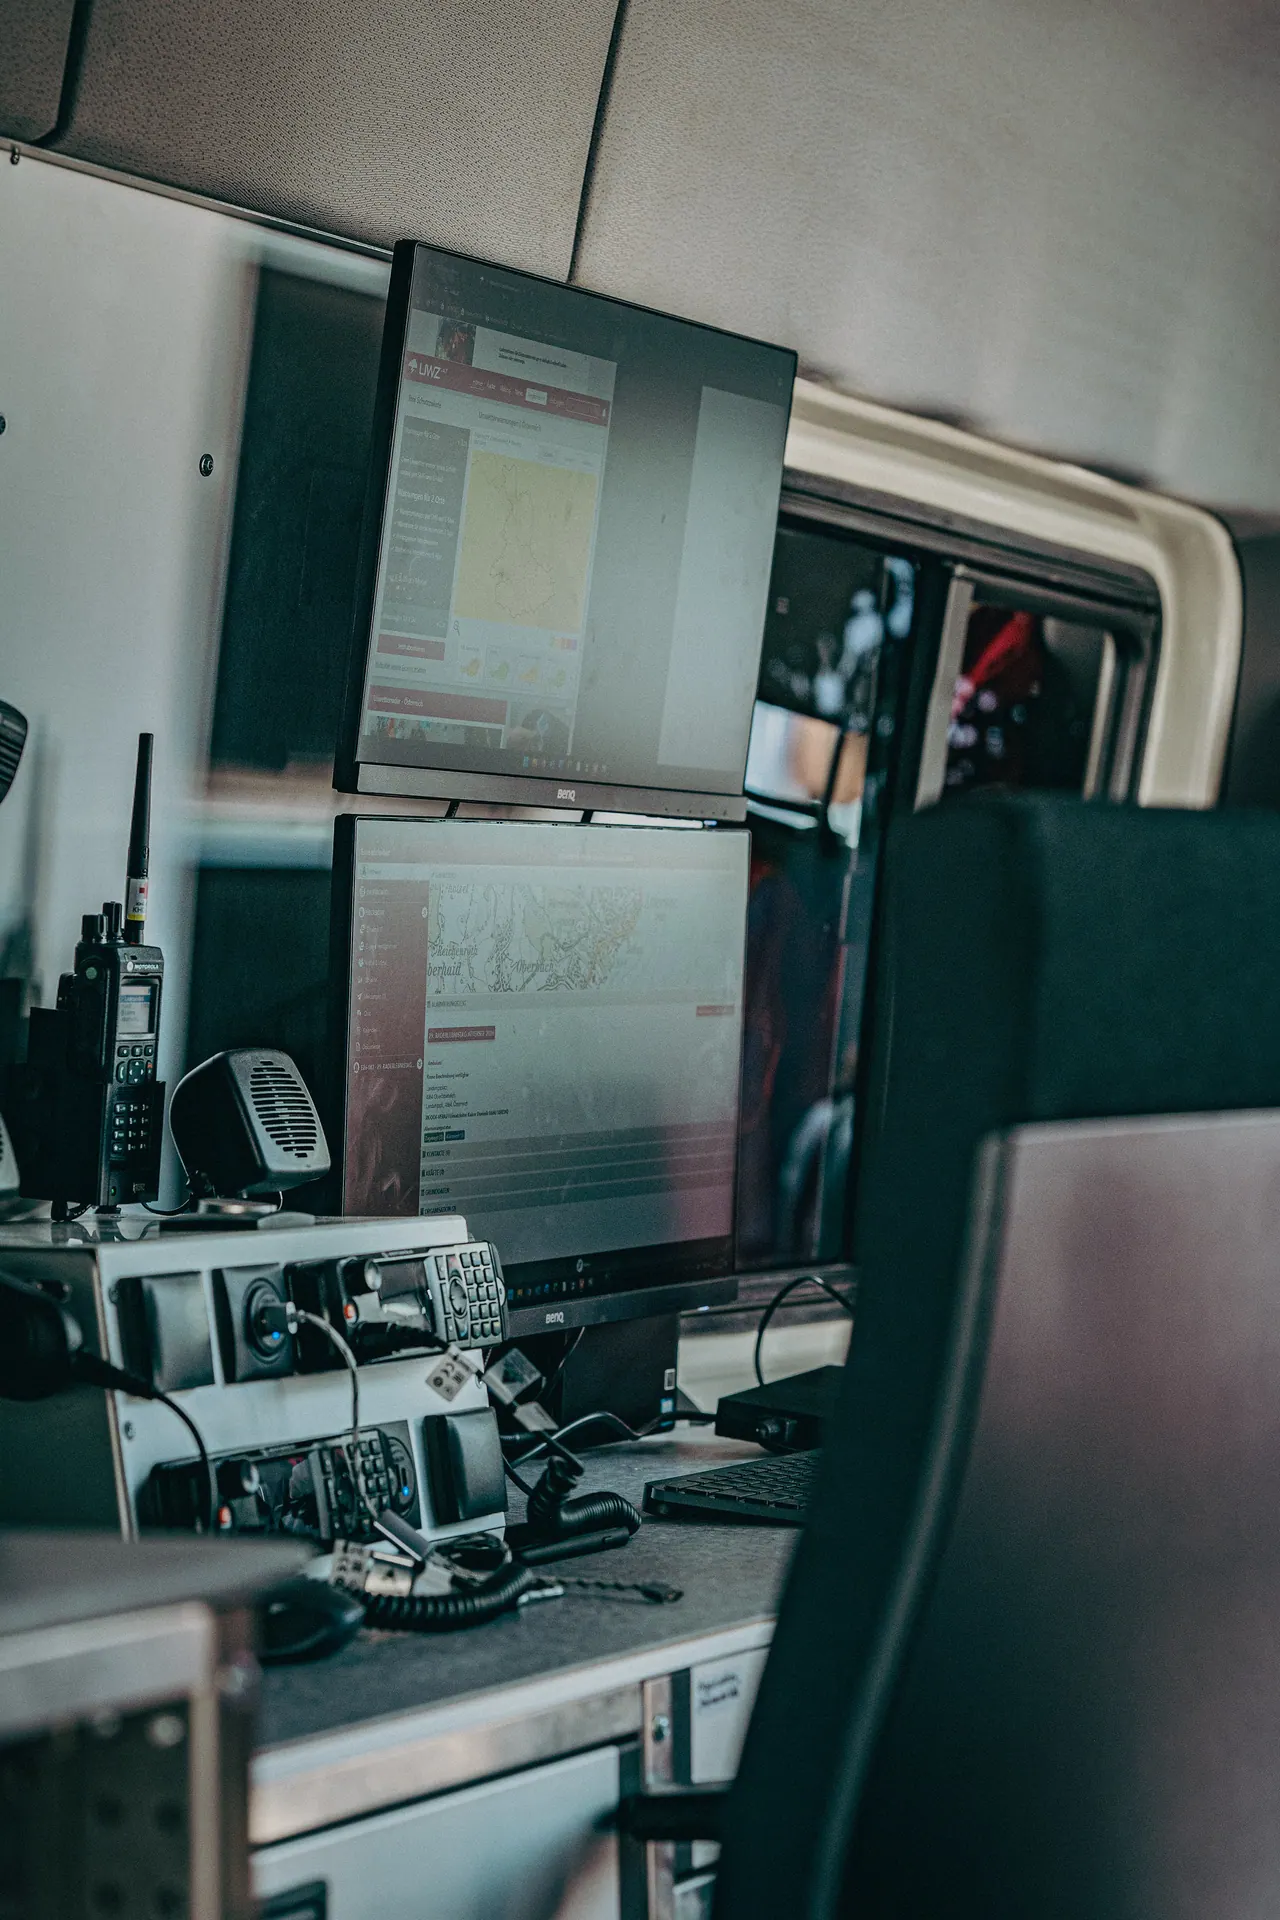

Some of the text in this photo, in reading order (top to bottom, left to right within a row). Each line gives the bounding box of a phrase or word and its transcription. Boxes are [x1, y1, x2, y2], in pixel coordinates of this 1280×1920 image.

[419, 362, 441, 380] UWZ
[557, 788, 576, 802] BenQ
[545, 1311, 565, 1324] BenQ
